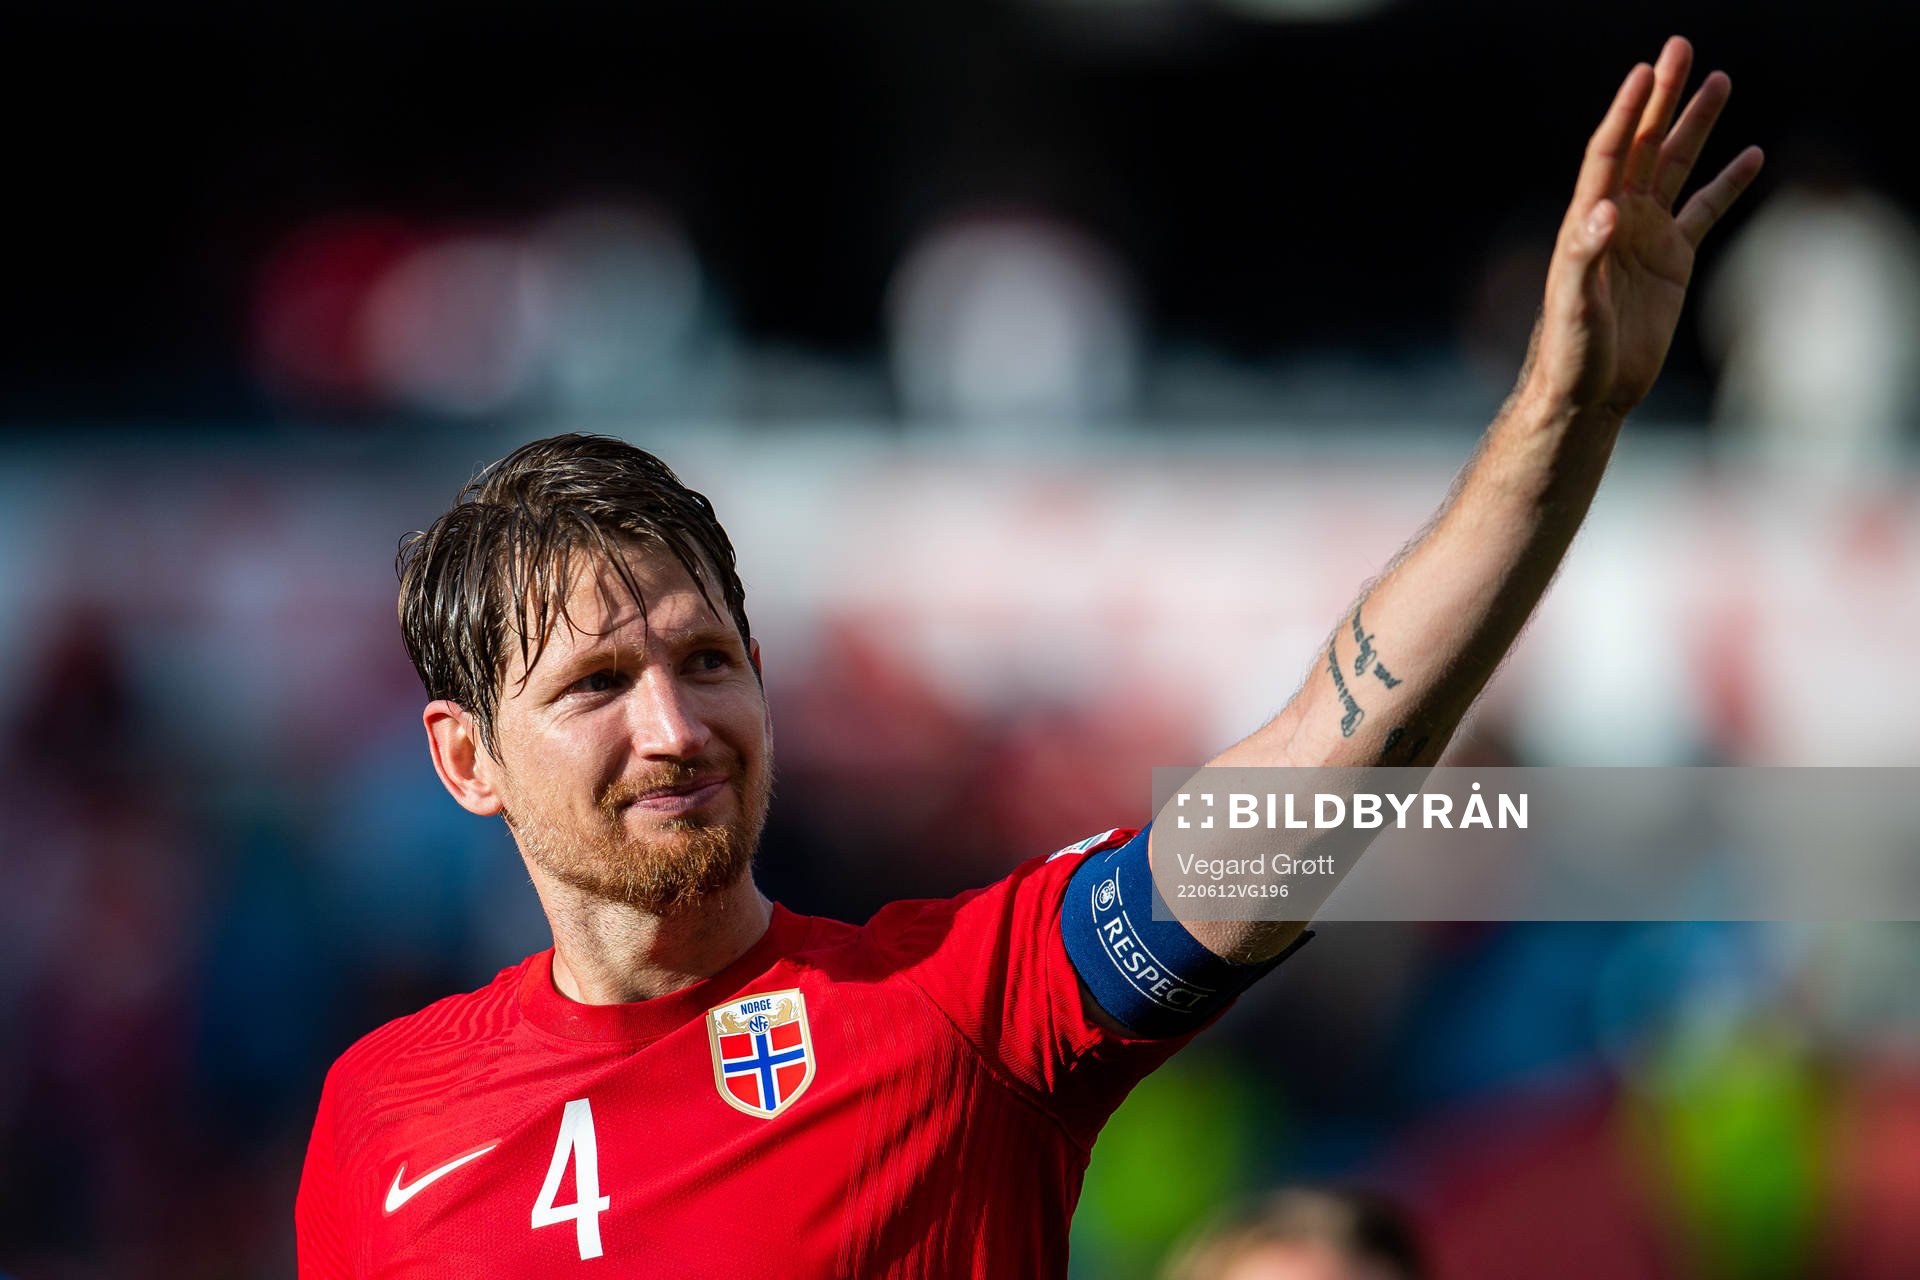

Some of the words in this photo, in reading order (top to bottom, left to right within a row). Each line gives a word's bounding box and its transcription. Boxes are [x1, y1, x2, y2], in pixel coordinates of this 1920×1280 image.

[740, 999, 772, 1015] NORGE
[1103, 917, 1208, 1008] RESPECT
[531, 1097, 610, 1260] 4
